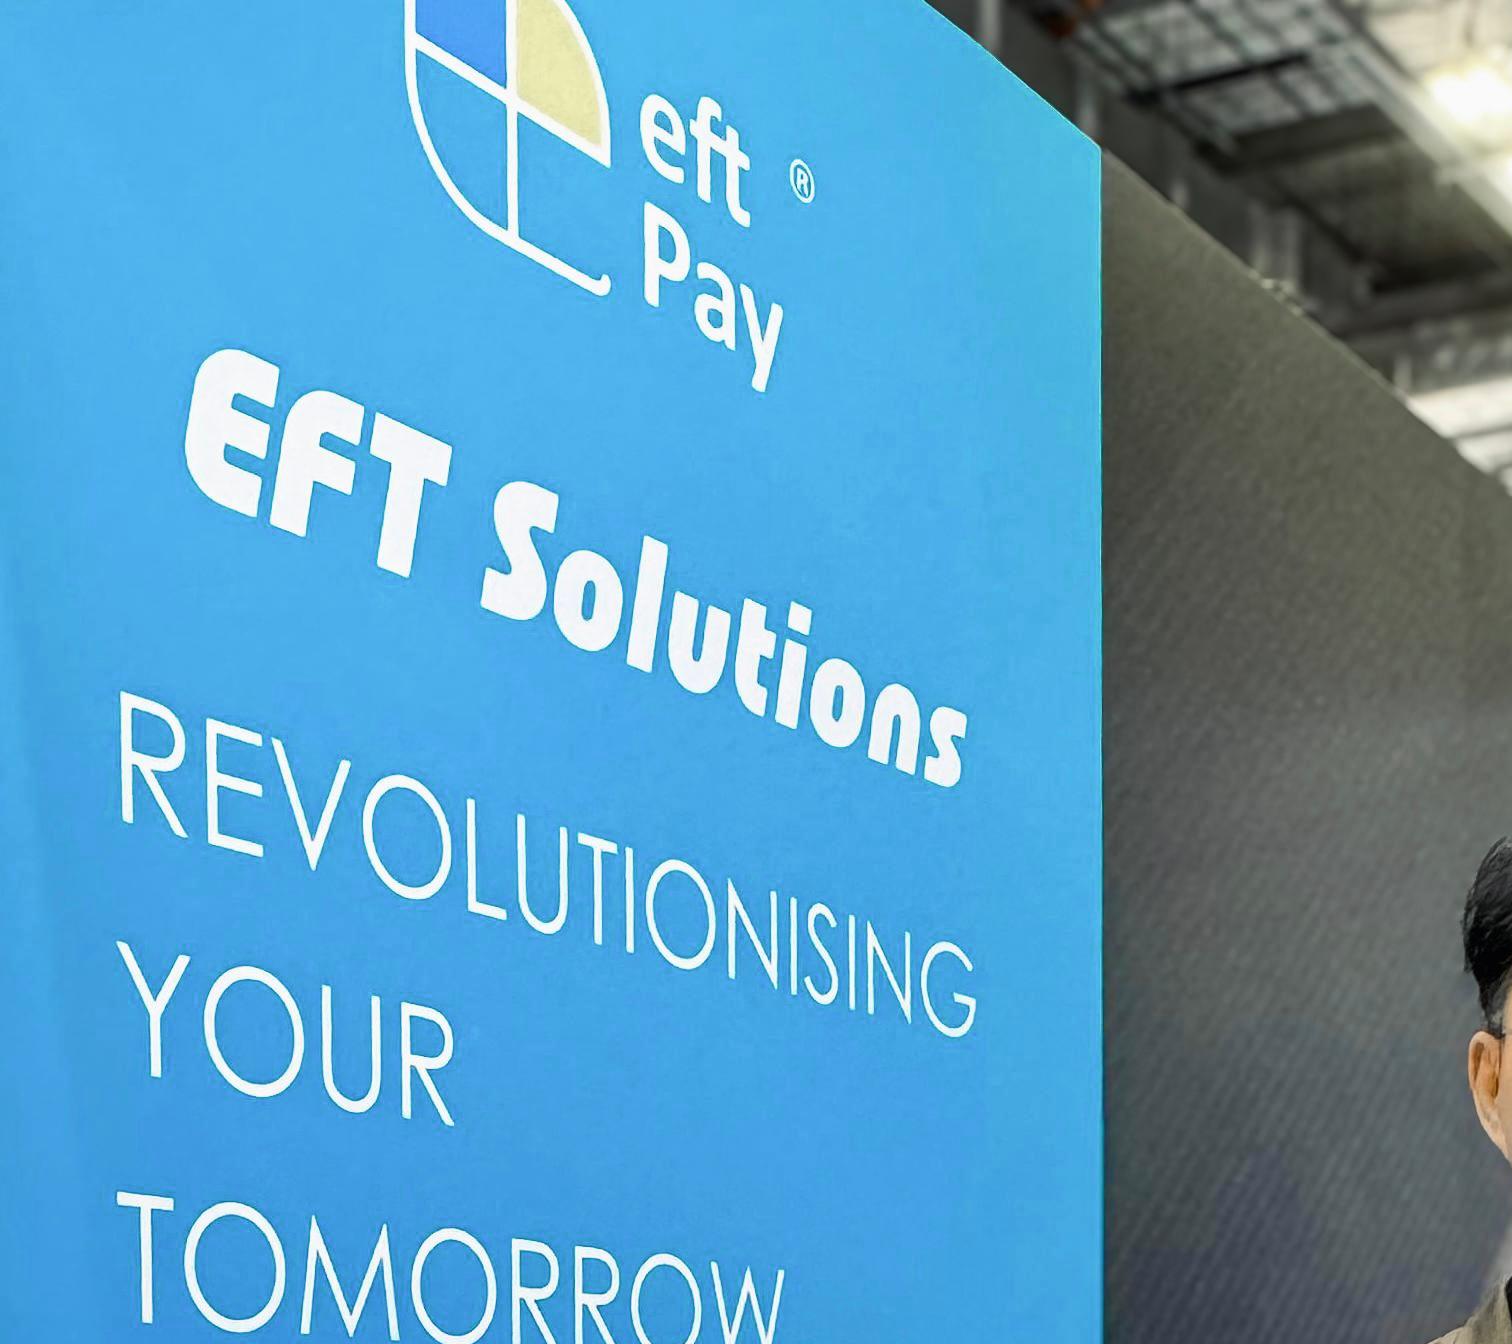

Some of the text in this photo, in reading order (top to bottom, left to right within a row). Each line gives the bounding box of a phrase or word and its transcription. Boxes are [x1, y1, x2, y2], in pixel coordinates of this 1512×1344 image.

[640, 93, 750, 227] eft
[643, 202, 783, 393] Pay
[184, 348, 967, 788] EFT Solutions
[119, 691, 977, 1038] REVOLUTIONISING
[116, 941, 454, 1126] YOUR
